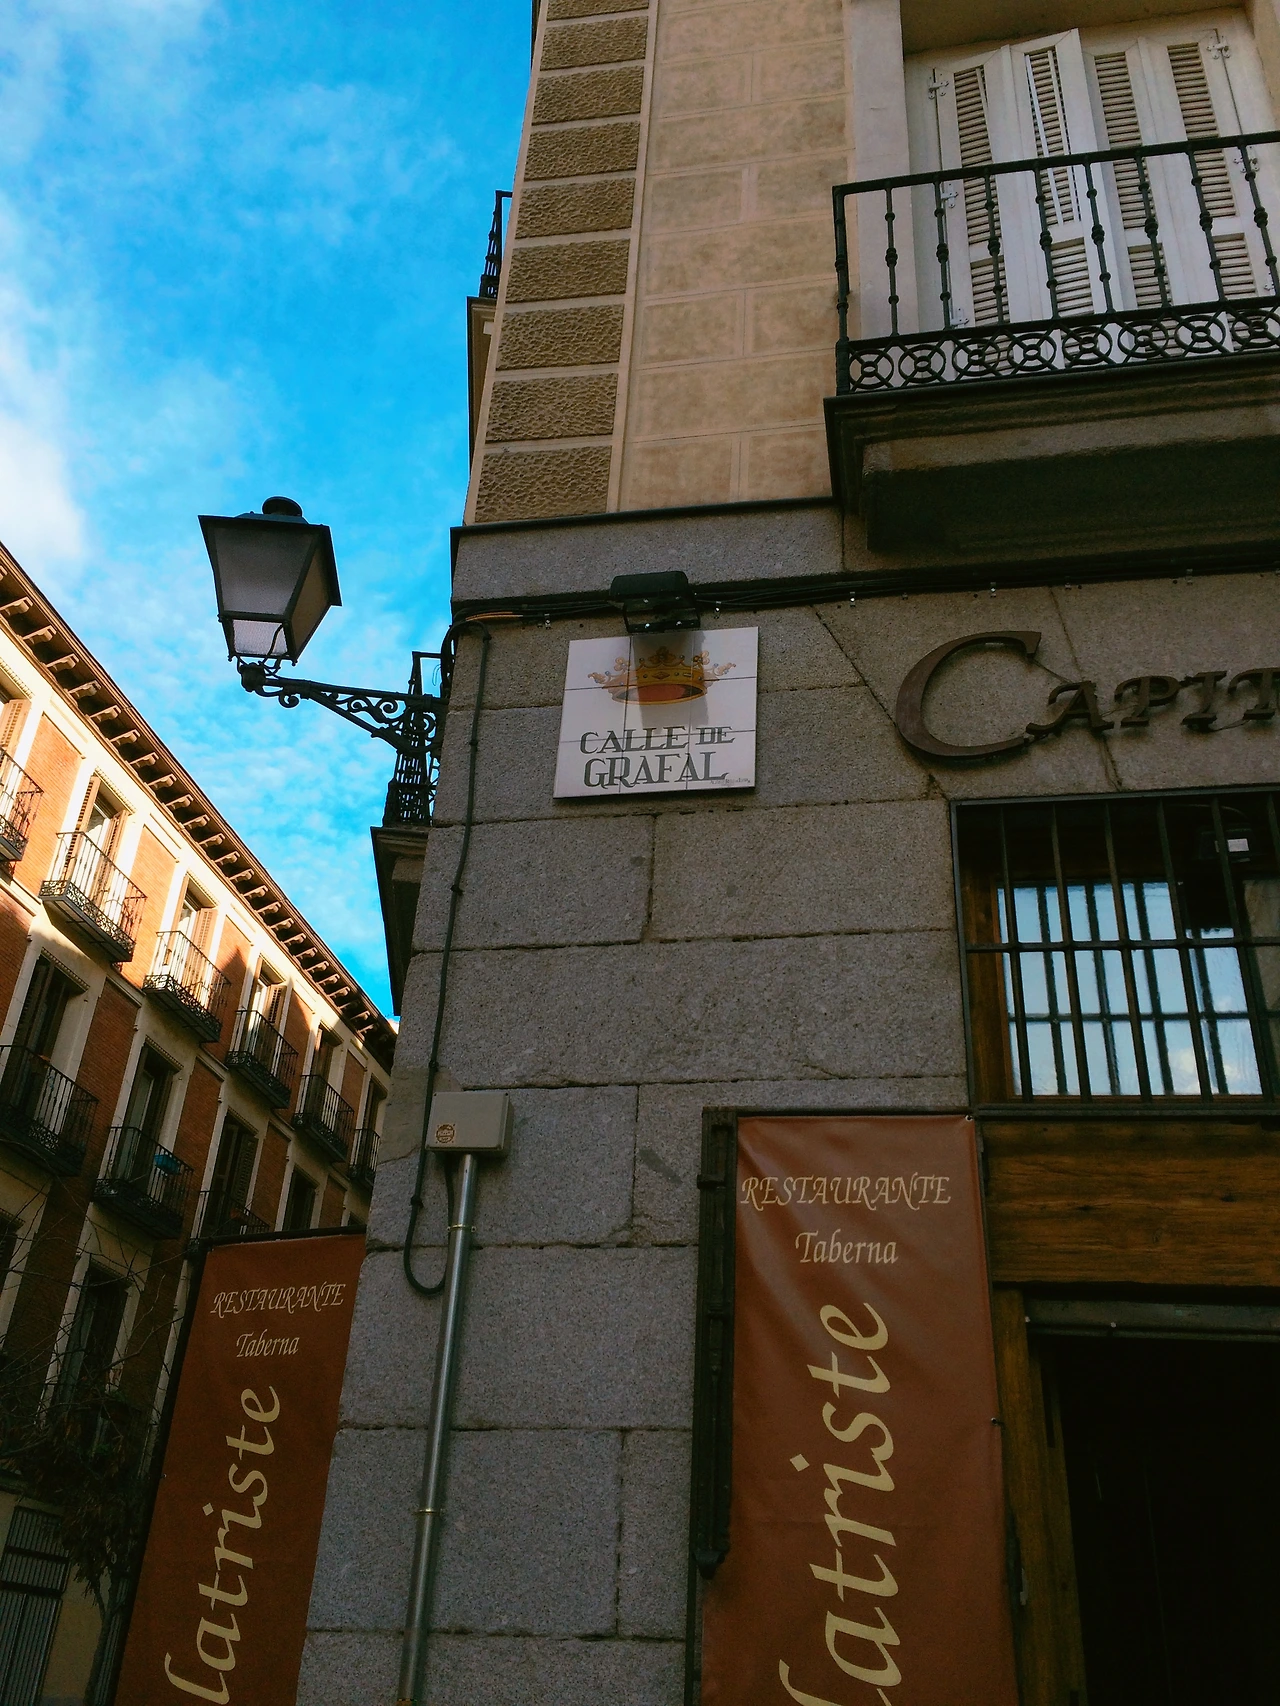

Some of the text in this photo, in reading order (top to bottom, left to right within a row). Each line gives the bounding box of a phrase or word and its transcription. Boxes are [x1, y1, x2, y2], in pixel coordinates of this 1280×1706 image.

[579, 725, 736, 755] CALLE DE
[583, 751, 730, 790] GRAFAL
[740, 1171, 952, 1212] RESTAURANTE
[795, 1228, 899, 1264] Taberna
[210, 1281, 346, 1319] RESTAURANTE
[236, 1328, 300, 1358] Taberna
